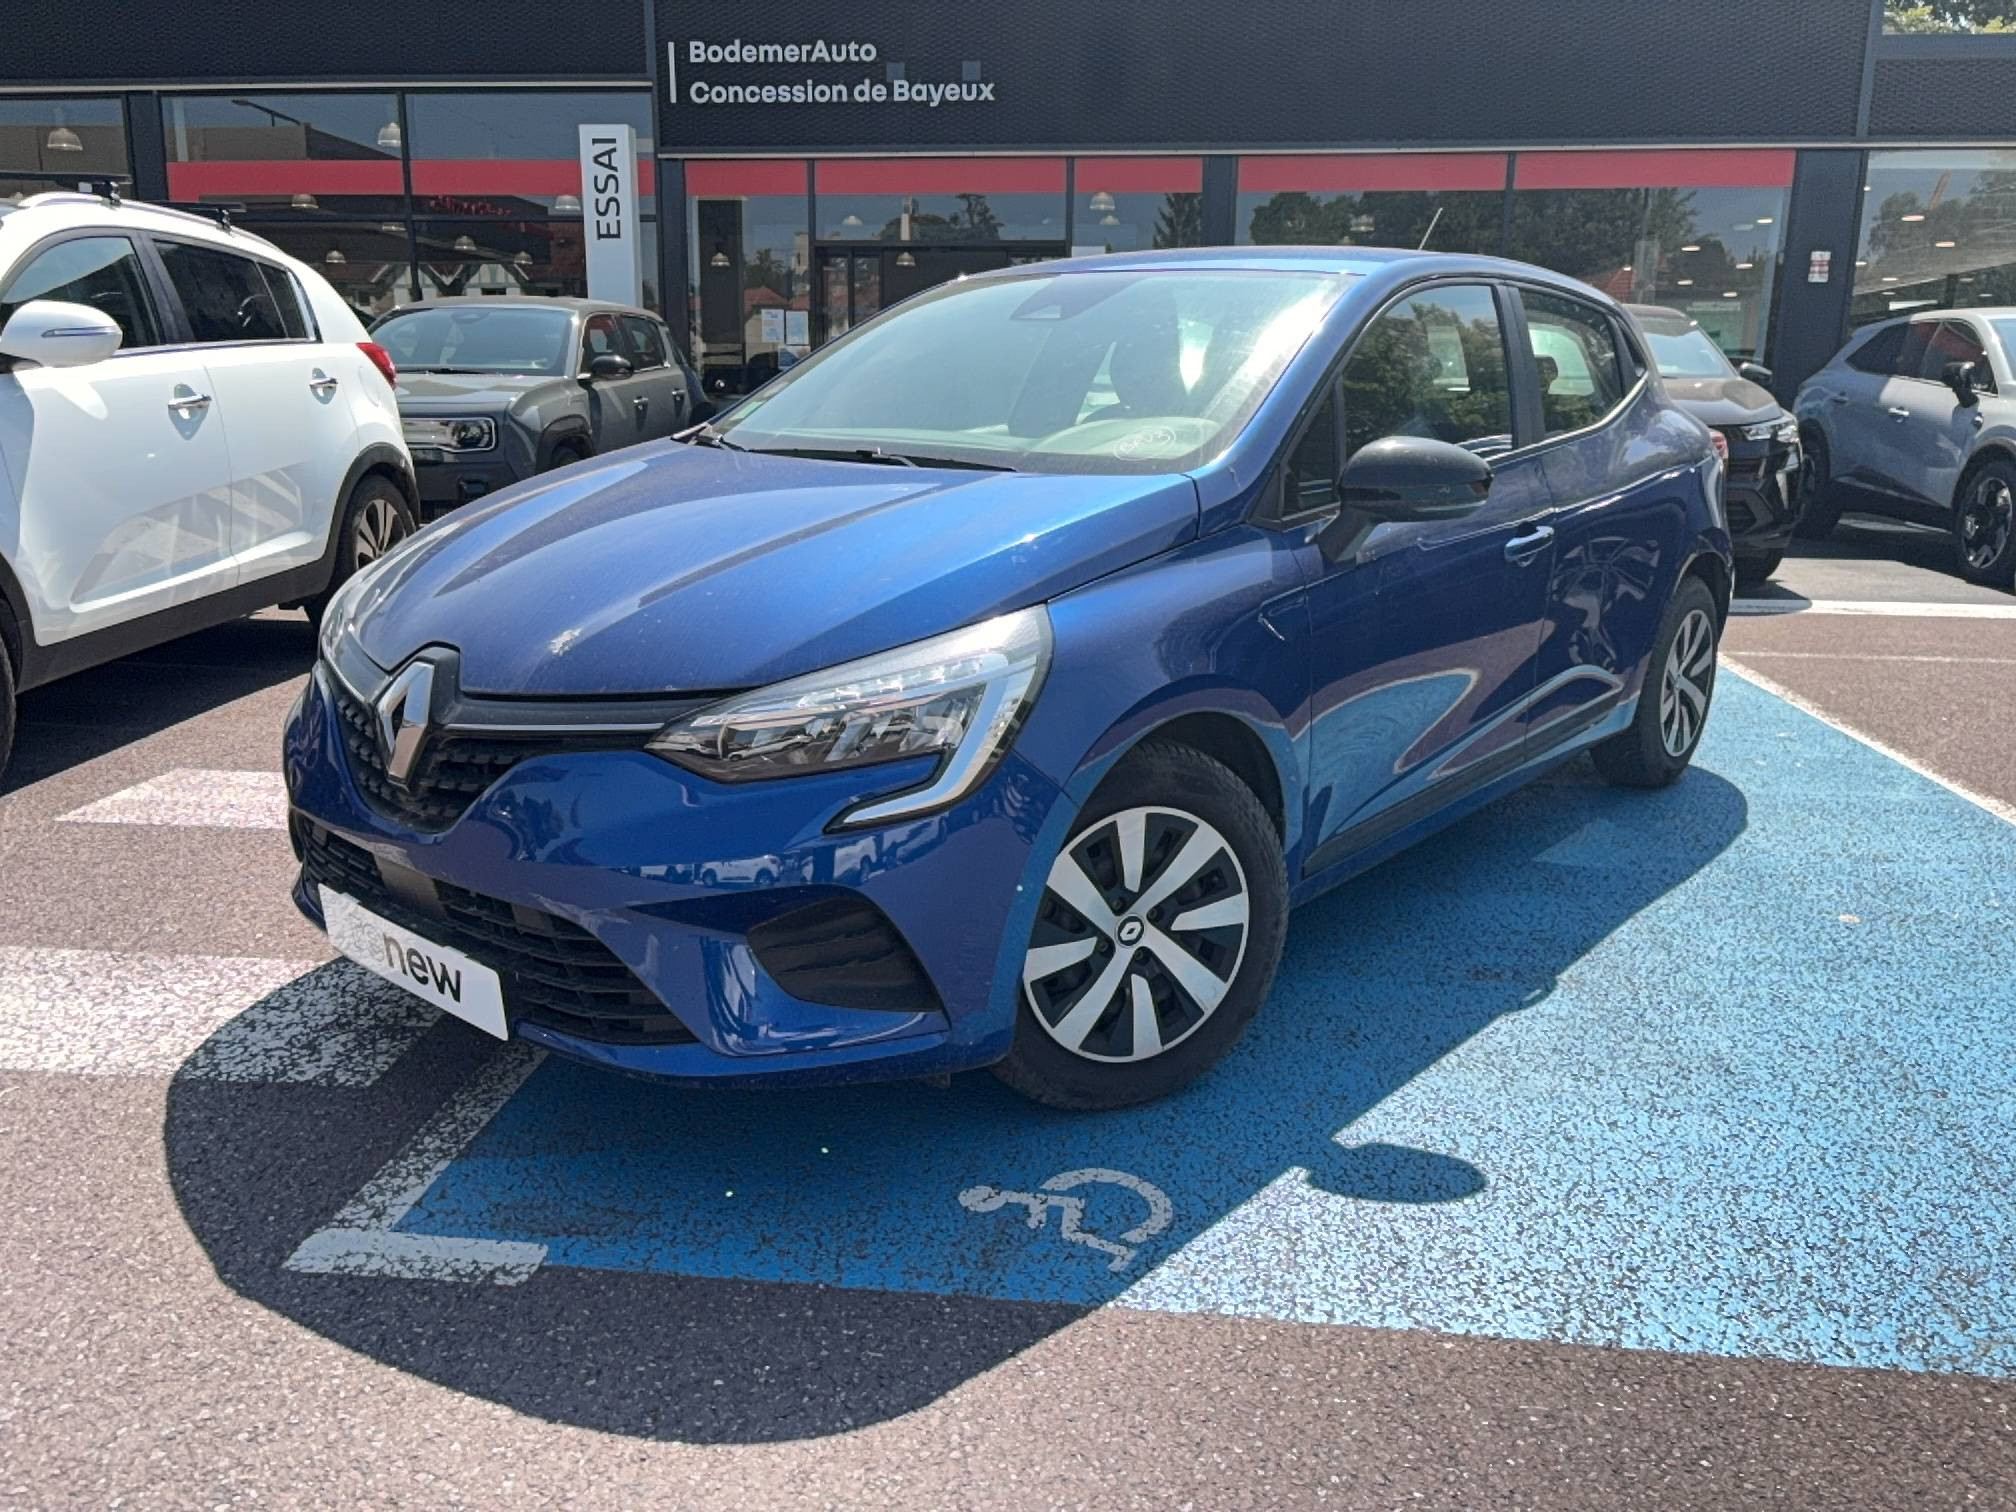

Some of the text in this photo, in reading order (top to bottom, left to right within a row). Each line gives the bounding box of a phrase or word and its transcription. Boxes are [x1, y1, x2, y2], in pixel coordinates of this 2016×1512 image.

[689, 39, 877, 63] BodemerAuto
[690, 78, 995, 107] Concession de Bayeux
[591, 138, 621, 240] ESSAI
